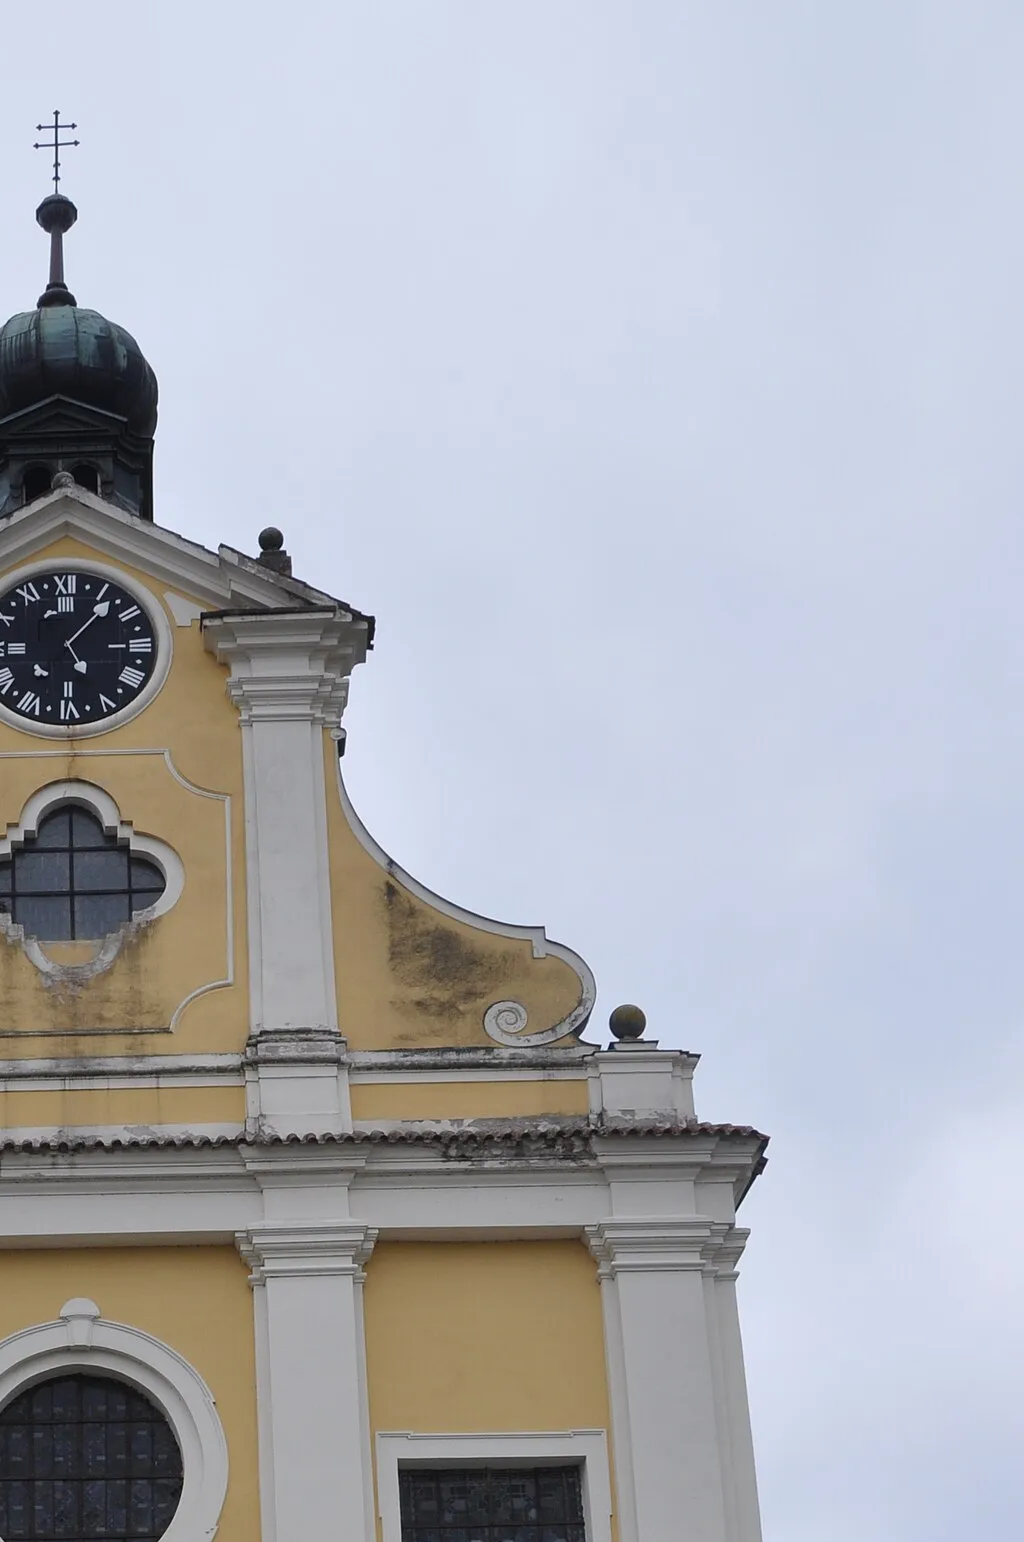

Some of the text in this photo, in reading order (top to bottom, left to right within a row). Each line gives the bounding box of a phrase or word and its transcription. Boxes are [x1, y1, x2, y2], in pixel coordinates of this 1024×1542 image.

[16, 582, 40, 606] XI
[54, 575, 77, 595] XII
[118, 605, 141, 622] II
[129, 638, 152, 653] III
[118, 666, 146, 688] IIII
[16, 691, 40, 716] VII
[60, 700, 80, 720] VI
[99, 693, 117, 712] V
